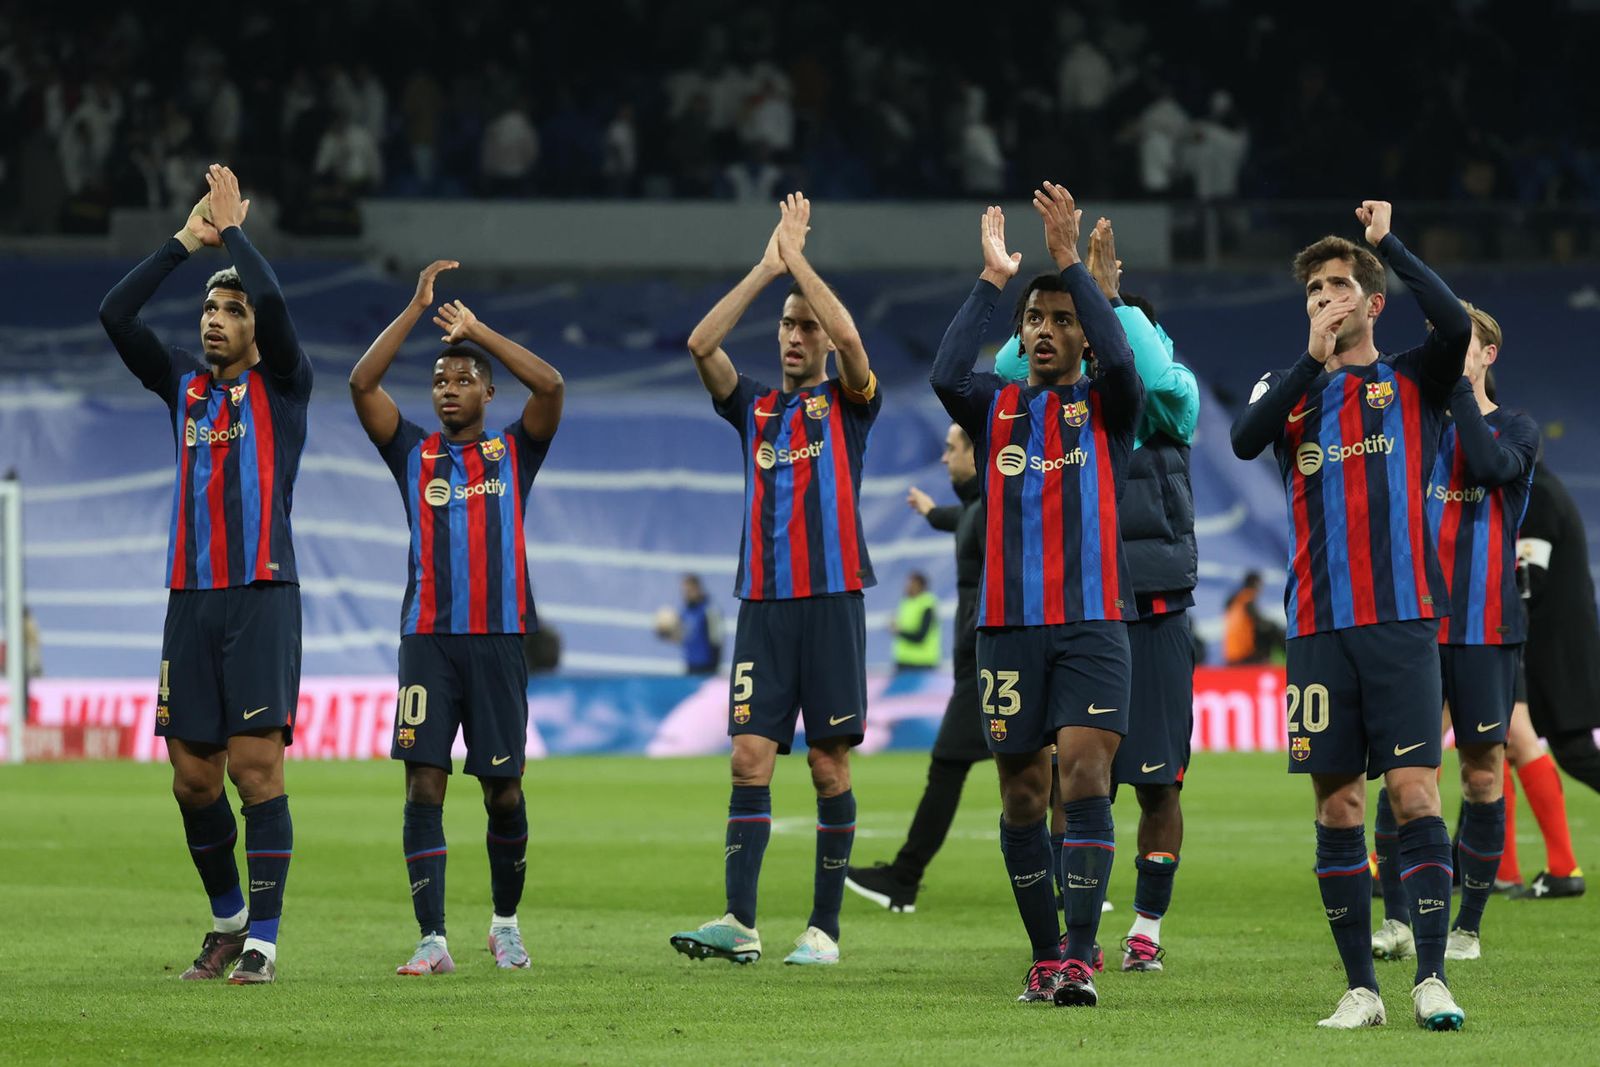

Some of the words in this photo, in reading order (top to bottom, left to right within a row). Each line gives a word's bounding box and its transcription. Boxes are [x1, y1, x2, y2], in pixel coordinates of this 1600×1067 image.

[778, 441, 824, 464] Spotif
[1029, 447, 1089, 473] Spotify
[1328, 434, 1395, 462] Spotify
[453, 479, 507, 500] Spotify
[1434, 485, 1486, 504] Spotify
[159, 661, 170, 701] 4
[734, 662, 754, 701] 5
[980, 668, 1021, 715] 23
[398, 684, 427, 726] 10
[1193, 672, 1288, 753] mi
[1286, 683, 1329, 733] 20
[1325, 906, 1348, 915] arça
